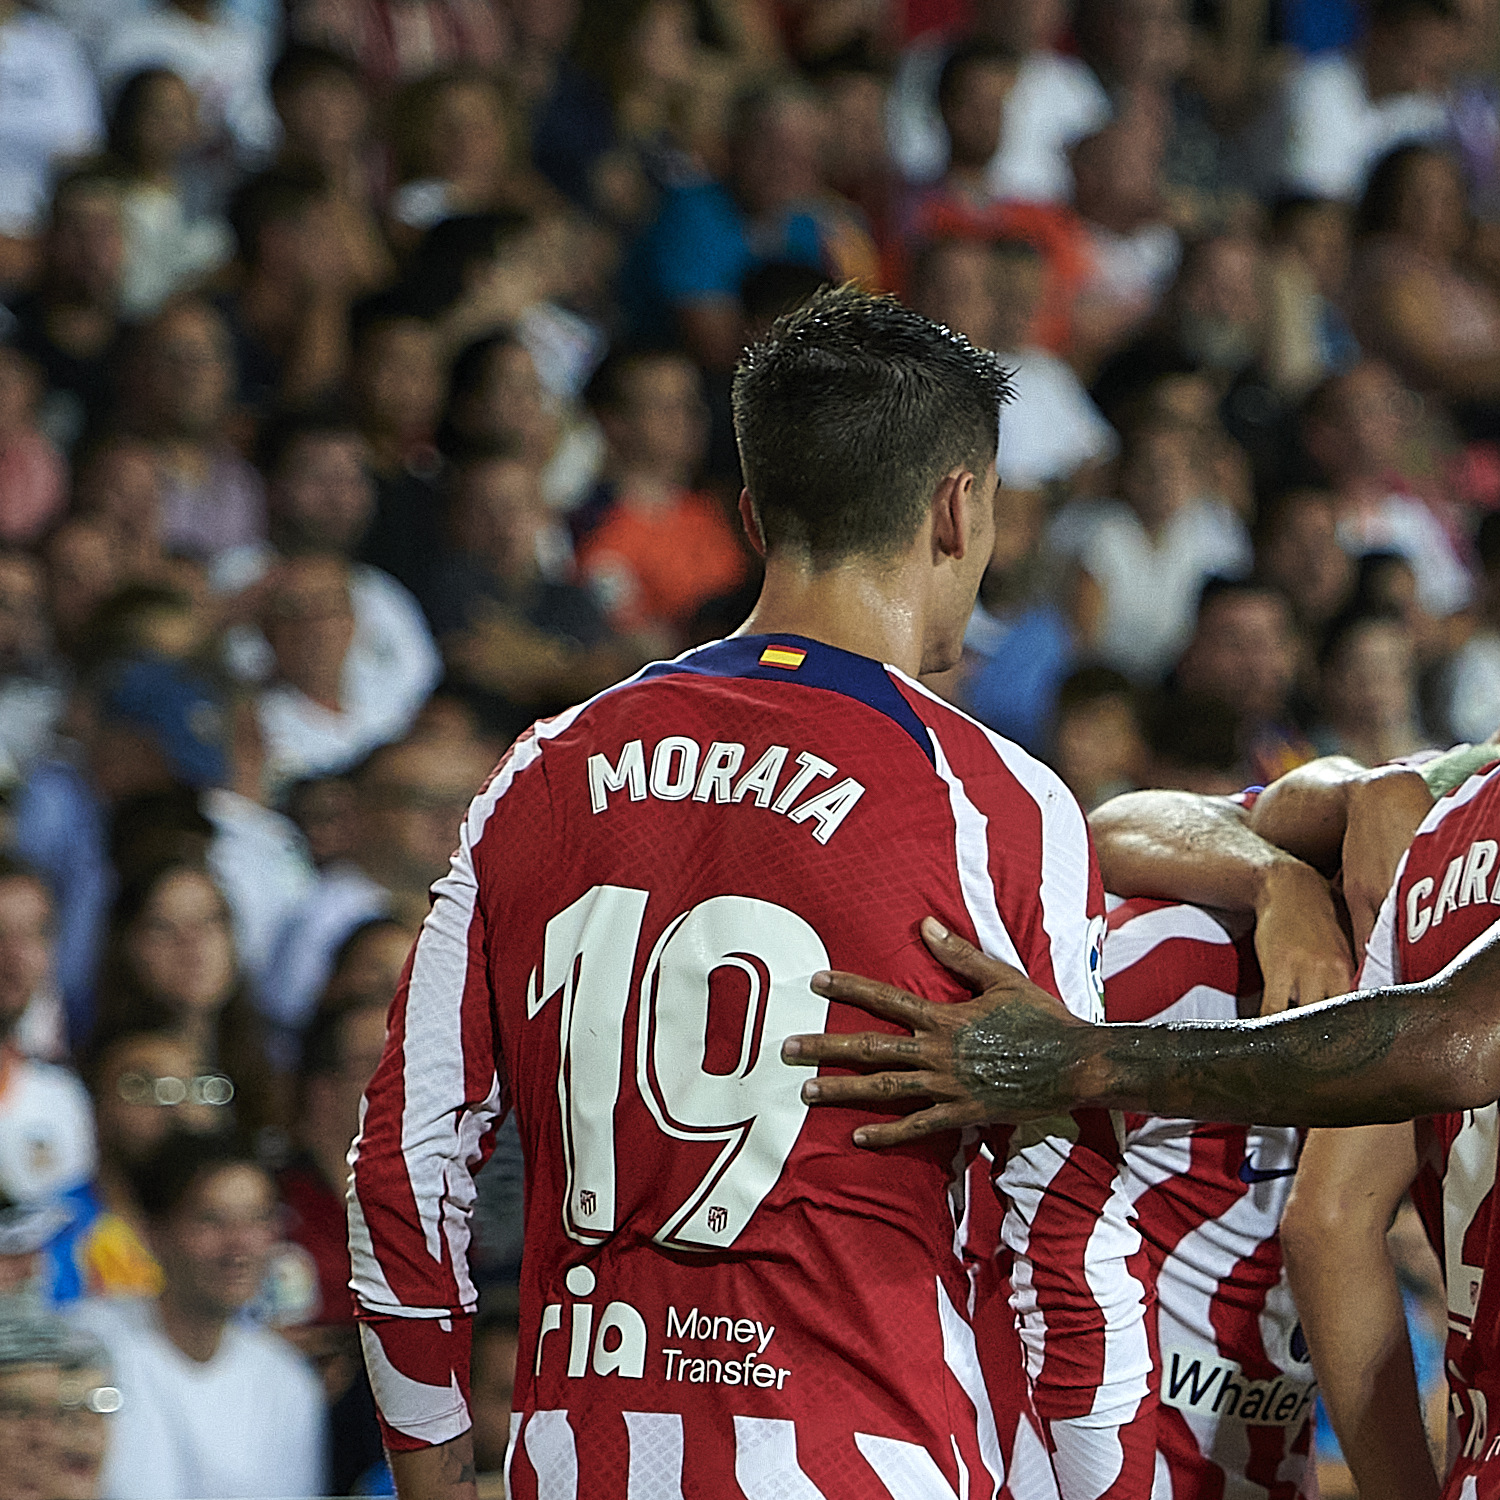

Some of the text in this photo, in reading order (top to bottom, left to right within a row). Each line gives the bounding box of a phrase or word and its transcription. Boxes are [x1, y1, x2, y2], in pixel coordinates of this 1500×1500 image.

[586, 735, 866, 845] MORATA
[527, 883, 832, 1252] 19
[666, 1305, 776, 1353] Money
[661, 1348, 792, 1391] Transfer
